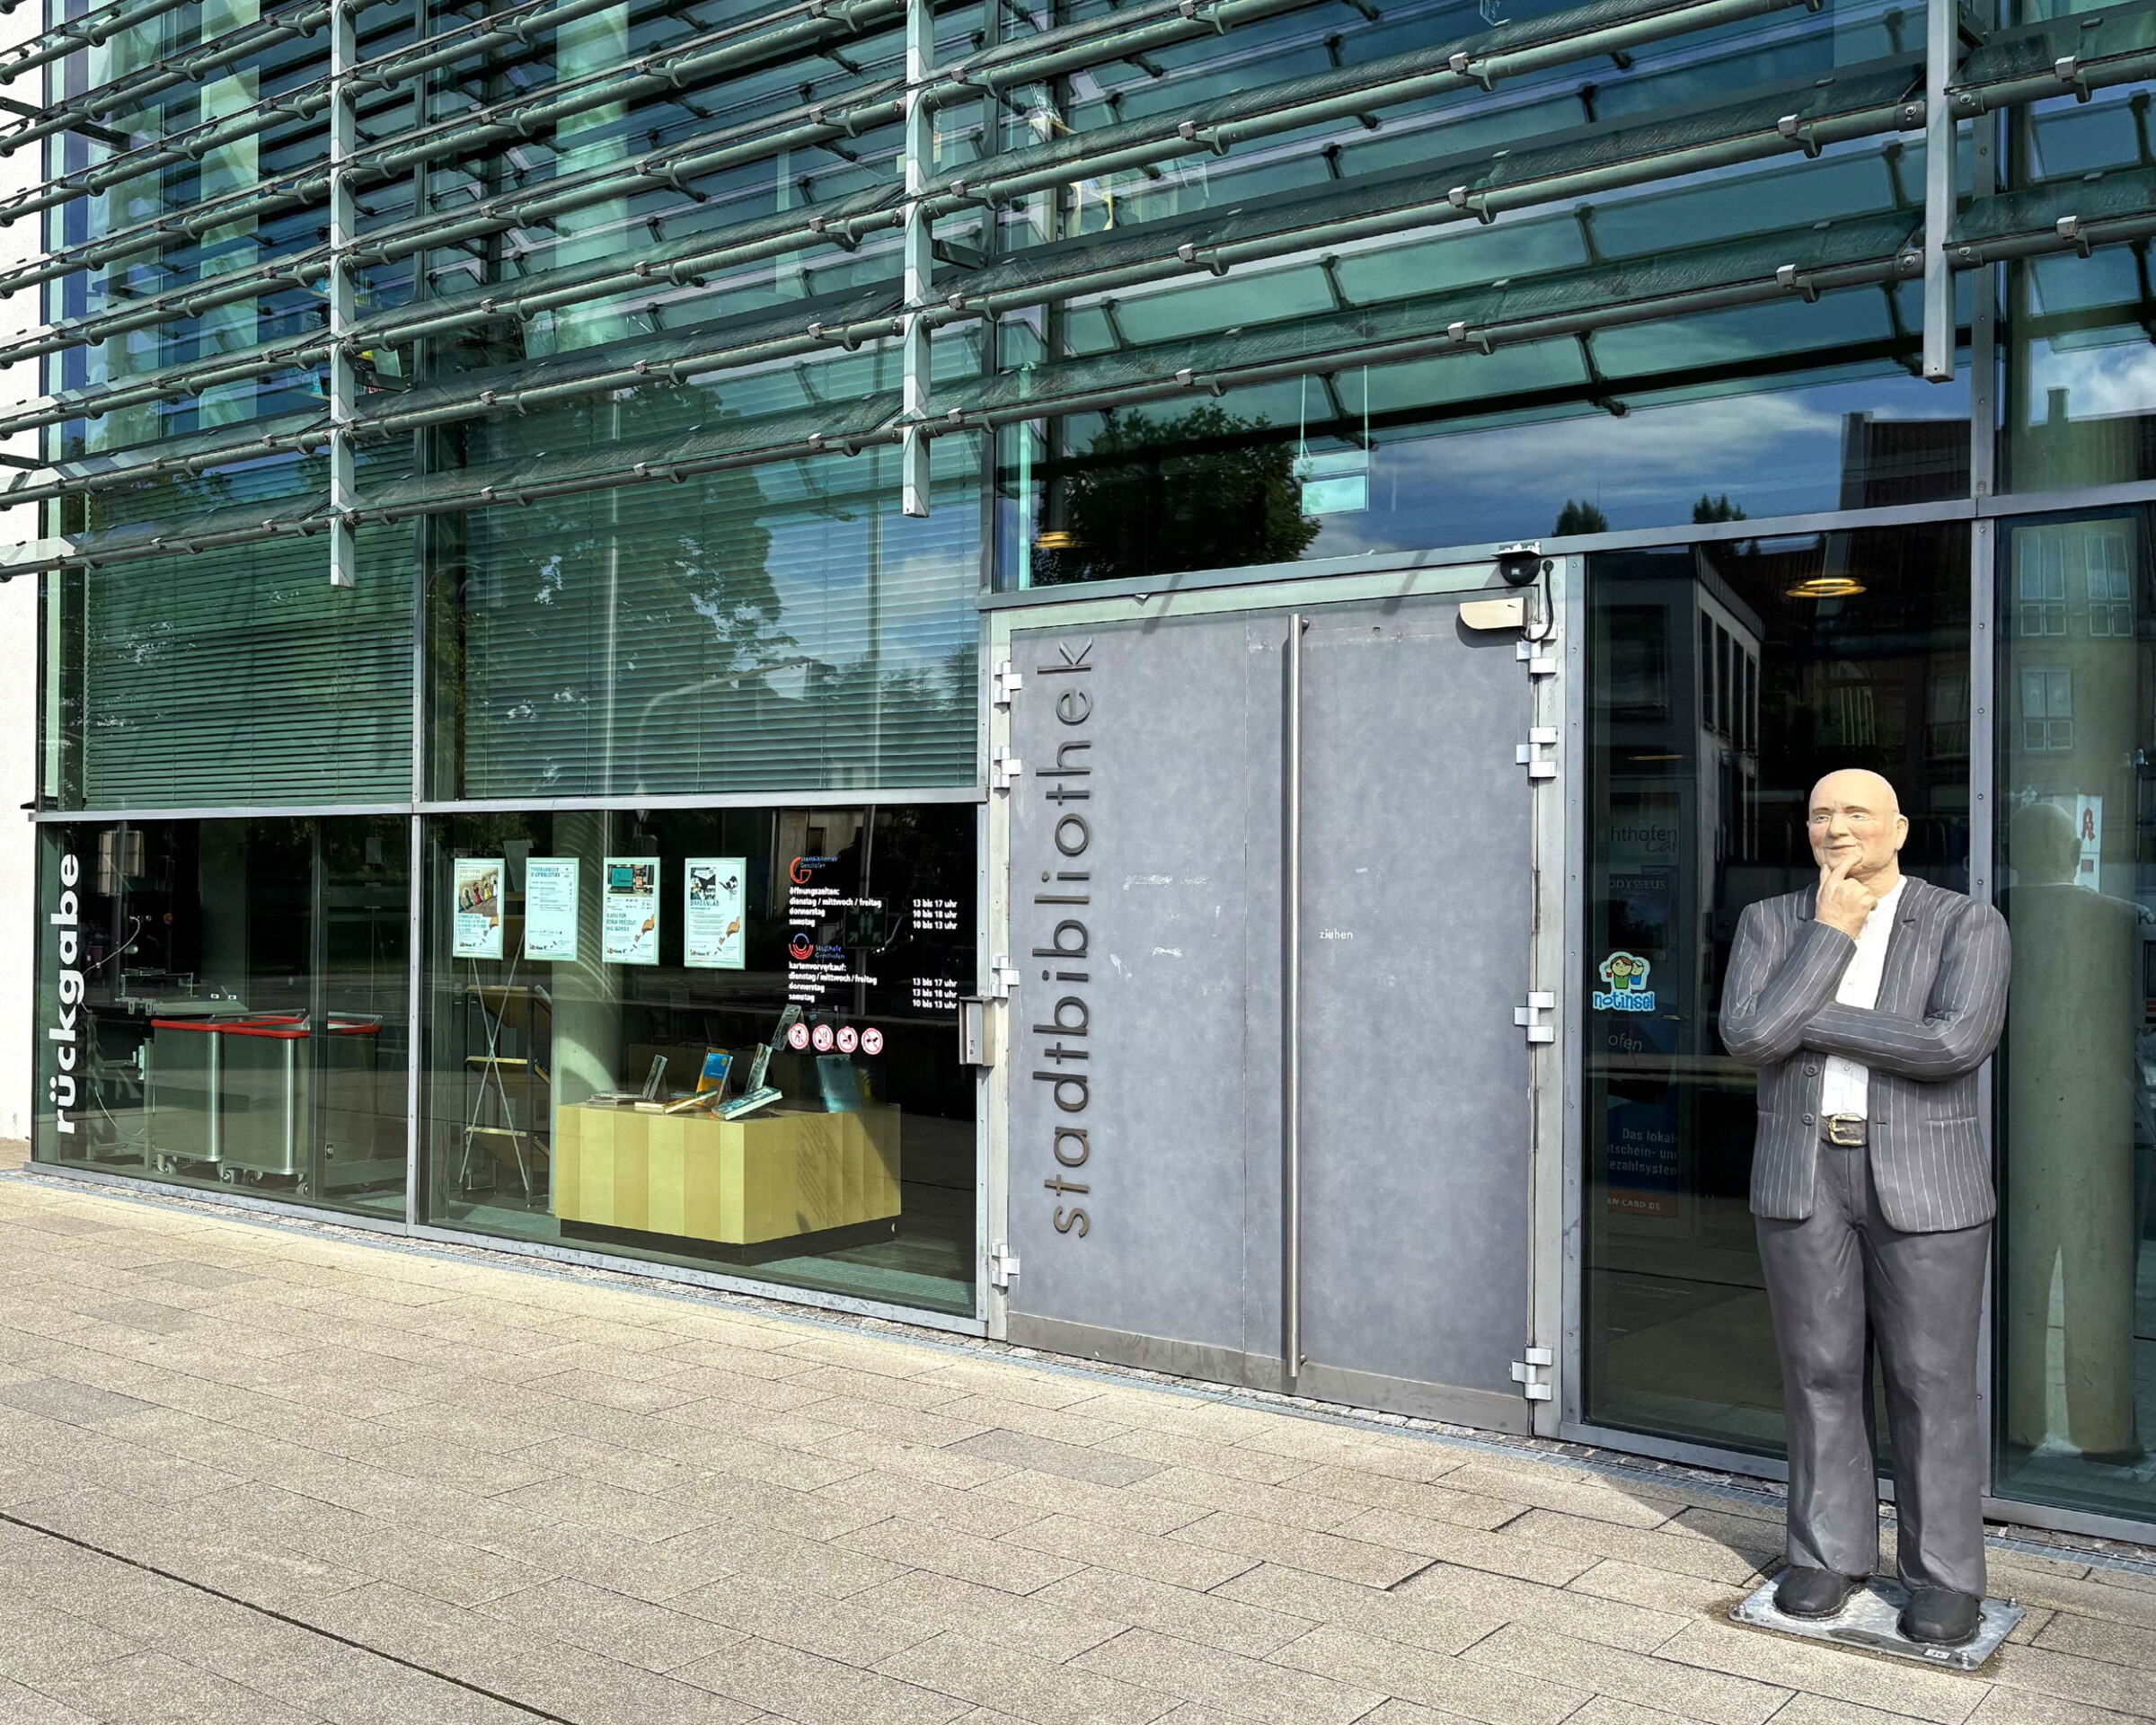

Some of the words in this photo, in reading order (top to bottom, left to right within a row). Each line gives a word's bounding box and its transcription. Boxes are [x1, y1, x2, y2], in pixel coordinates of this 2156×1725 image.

[790, 897, 817, 907] dienstag
[822, 898, 853, 906] mittwoch
[859, 898, 882, 908] freitag
[913, 898, 922, 907] 13
[922, 898, 933, 907] bis
[934, 899, 943, 907] 17
[944, 898, 958, 908] uhr
[789, 907, 826, 917] donnerstag
[913, 909, 922, 918] 10
[922, 909, 933, 918] bis
[944, 909, 958, 919] uhr
[789, 918, 816, 927] samstag
[913, 920, 922, 929] 10
[922, 920, 933, 929] bis
[934, 921, 943, 929] 13
[944, 920, 958, 930] uhr
[1032, 636, 1094, 1238] stadtbibliothek
[1319, 927, 1354, 940] ziehen
[789, 960, 846, 972] kartenvorverkauf:
[788, 971, 817, 982] dienstag
[820, 973, 851, 982] mittwoch
[855, 974, 878, 986] freitag
[913, 978, 922, 986] 13
[922, 978, 933, 986] bis
[934, 978, 943, 986] 17
[943, 978, 958, 987] uhr
[49, 854, 84, 1134] rückgabe
[788, 982, 826, 993] donnerstag
[913, 988, 922, 996] 13
[922, 988, 933, 997] bis
[943, 989, 958, 998] uhr
[788, 994, 815, 1004] samstag
[913, 999, 922, 1007] 10
[922, 999, 933, 1008] bis
[934, 1000, 943, 1008] 13
[943, 1000, 958, 1009] uhr
[1594, 992, 1655, 1011] notinsel
[1622, 1128, 1644, 1141] Das
